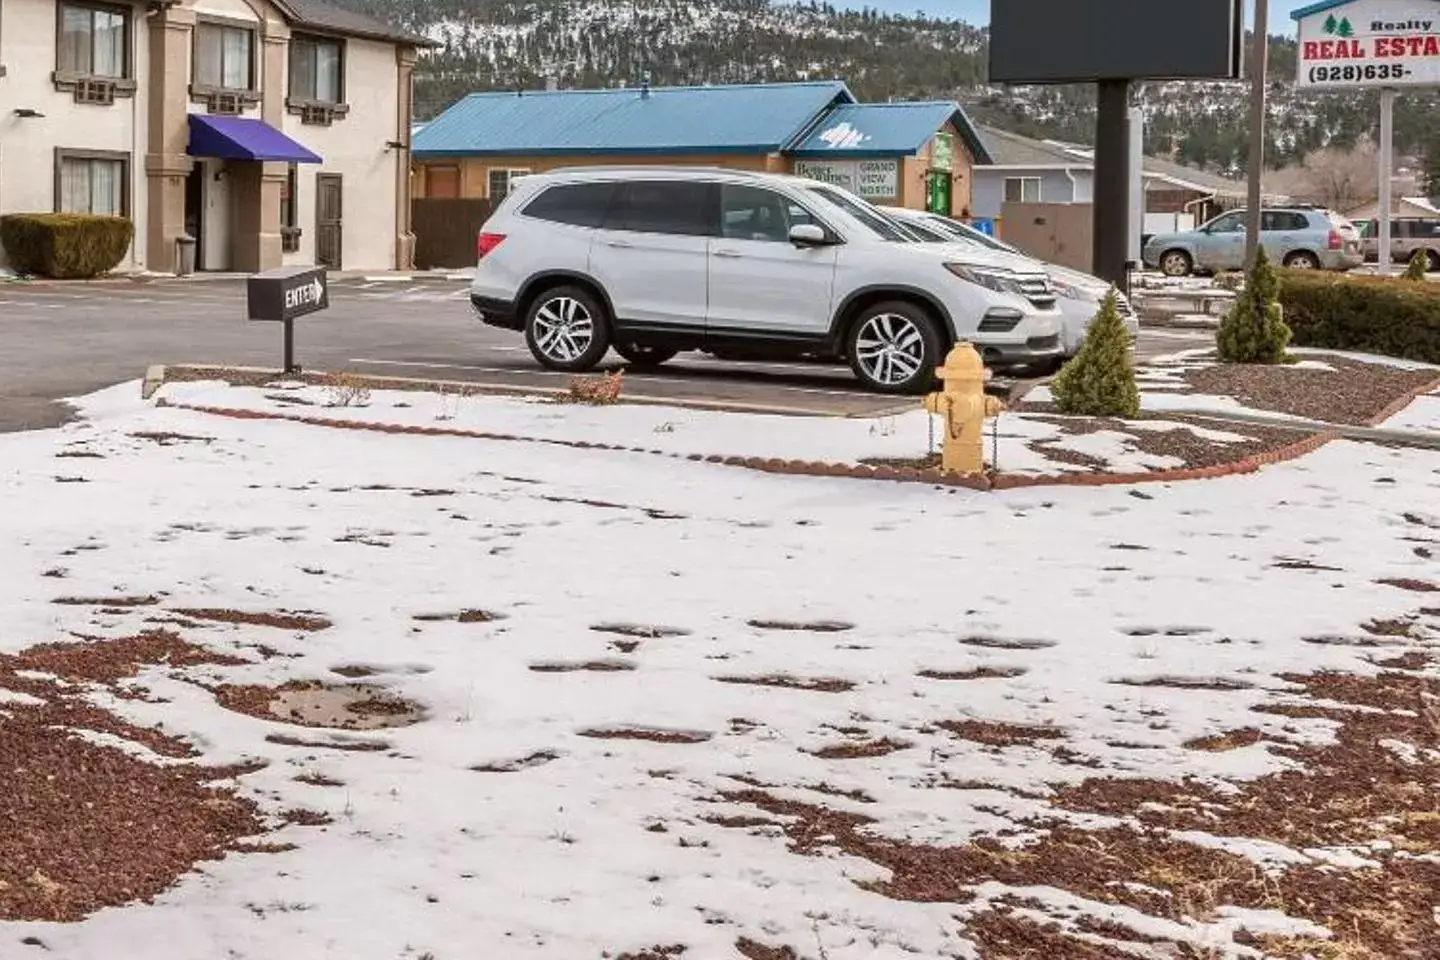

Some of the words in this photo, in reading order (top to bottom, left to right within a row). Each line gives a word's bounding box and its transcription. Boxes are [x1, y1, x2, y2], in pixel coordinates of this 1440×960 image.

[1370, 20, 1433, 32] Realty
[1303, 40, 1366, 60] REAL
[1374, 36, 1440, 58] ESTA
[1309, 64, 1412, 83] (928)635-
[859, 162, 896, 172] GRAND
[860, 174, 887, 183] VIEW
[859, 185, 894, 195] NORTH
[285, 284, 315, 309] ENTER
